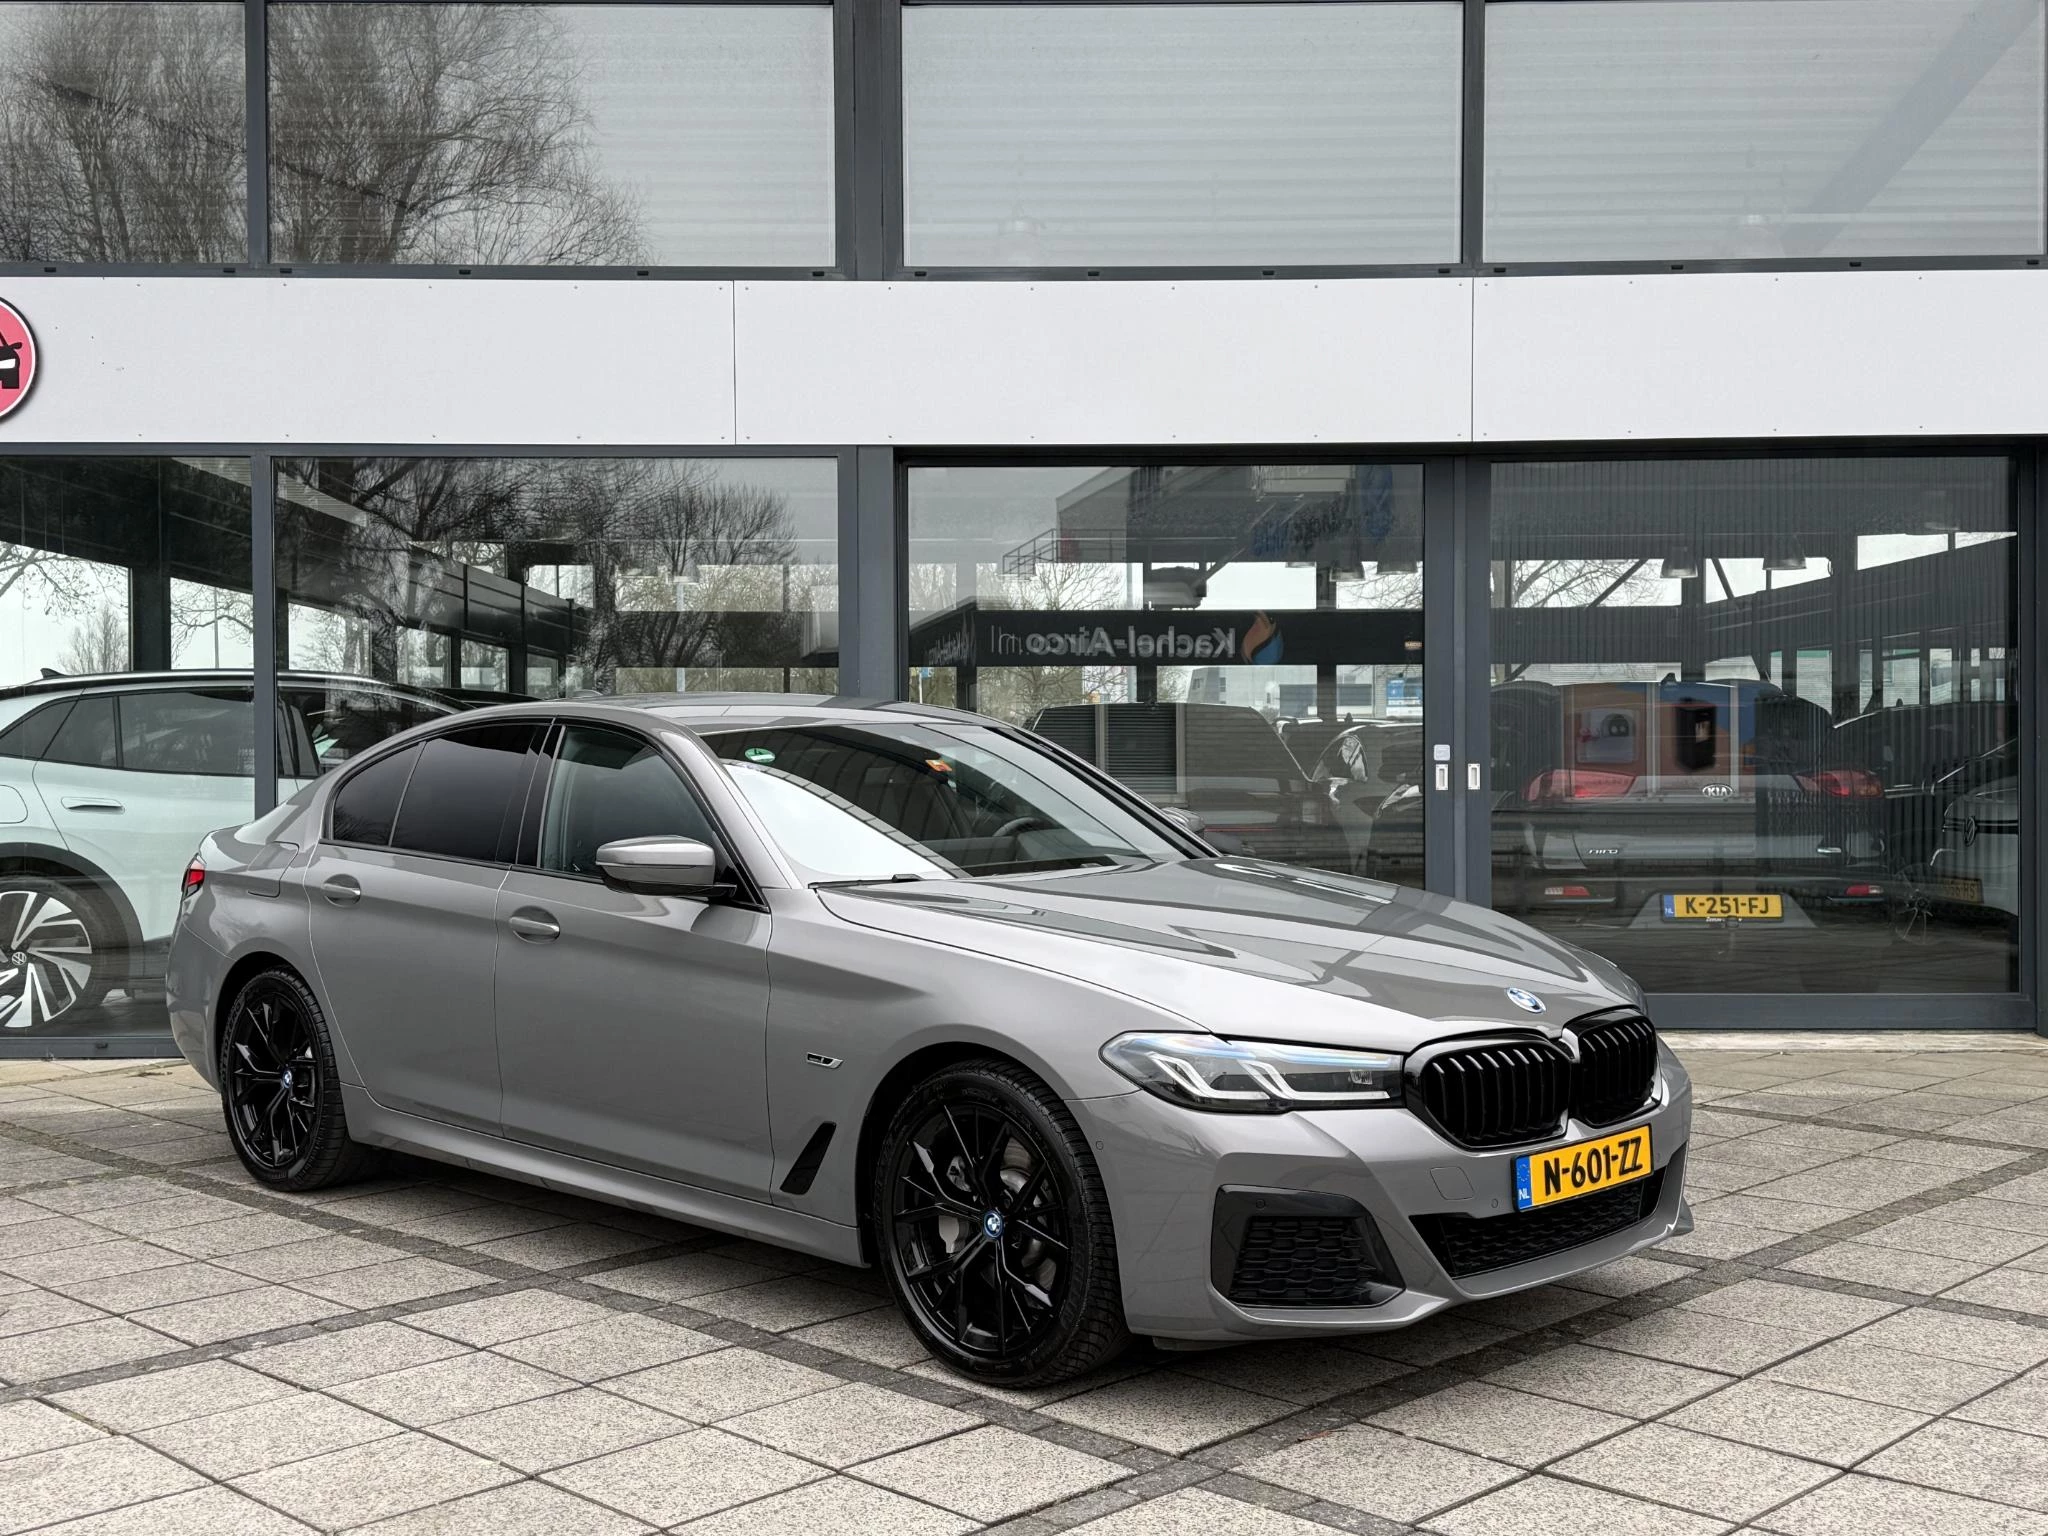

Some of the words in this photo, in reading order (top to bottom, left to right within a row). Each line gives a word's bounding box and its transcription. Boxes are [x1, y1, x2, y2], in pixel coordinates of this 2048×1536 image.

[1685, 896, 1769, 915] K-251-FJ
[1518, 1188, 1530, 1199] NL
[1544, 1137, 1643, 1197] N-601-ZZ
